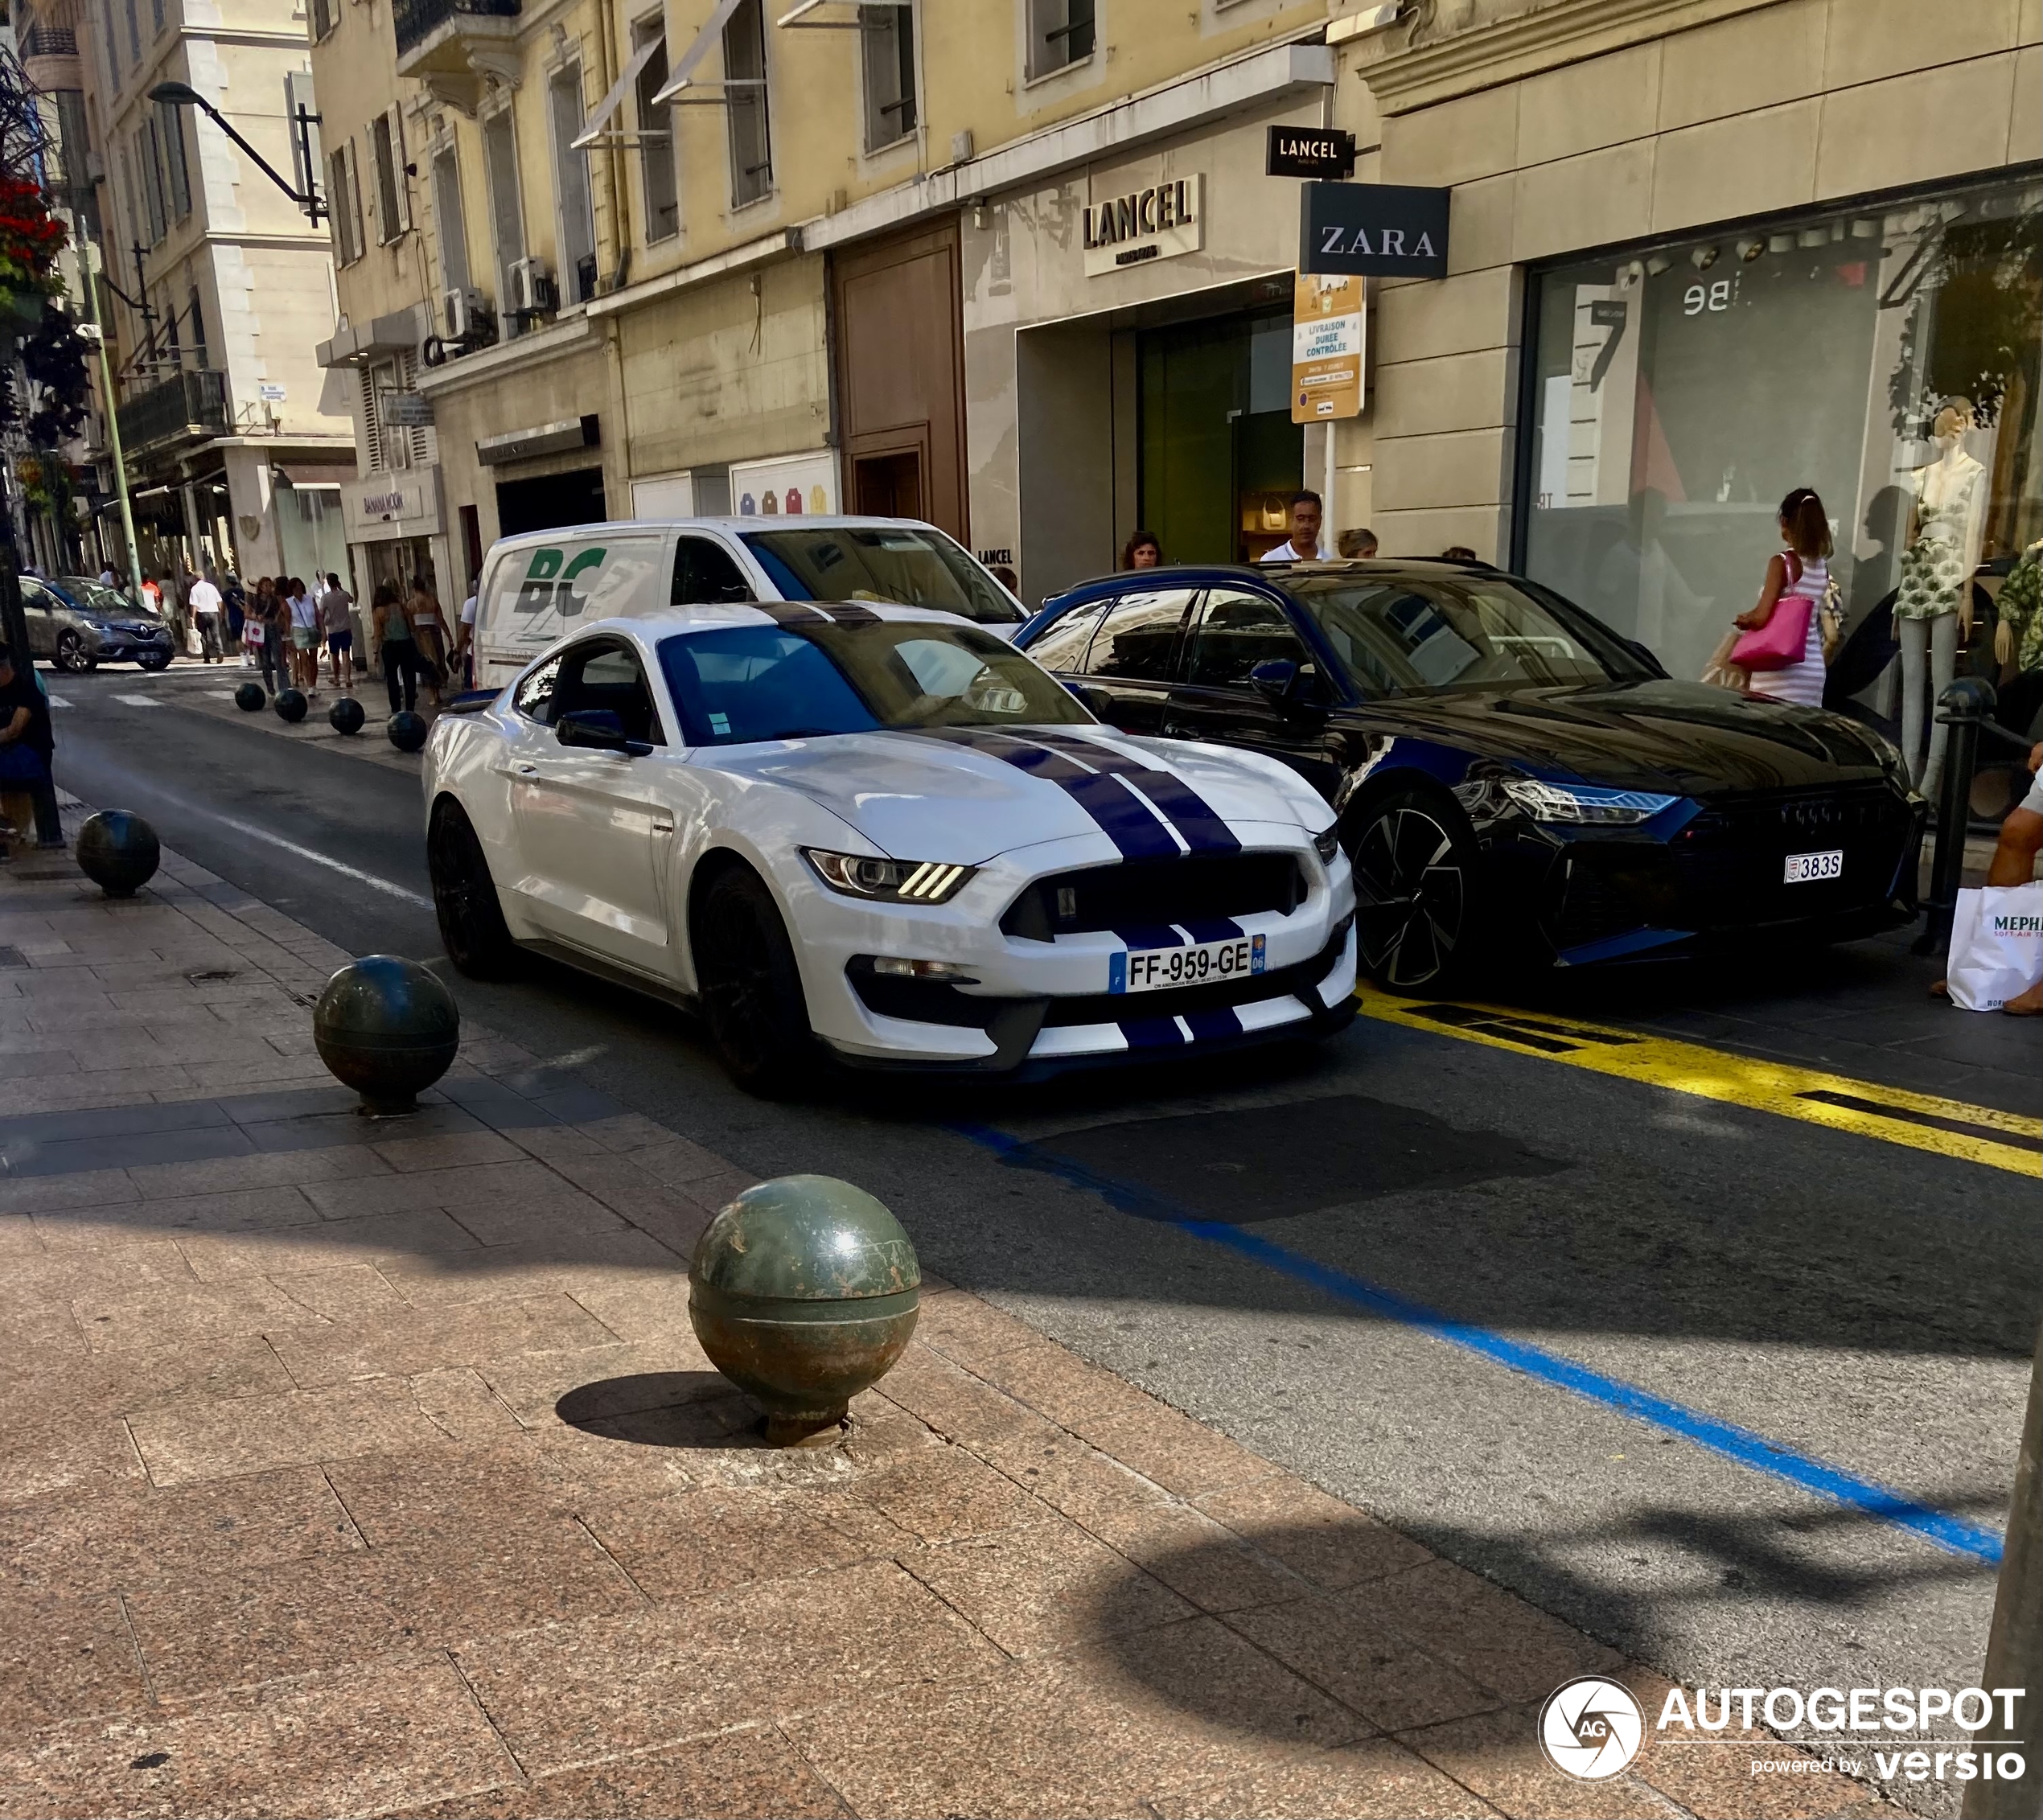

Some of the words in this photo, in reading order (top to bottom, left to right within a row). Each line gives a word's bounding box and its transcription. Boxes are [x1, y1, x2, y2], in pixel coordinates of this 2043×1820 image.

[1280, 138, 1338, 158] LANCEL
[1083, 180, 1193, 250] LANCEL
[1320, 226, 1438, 257] ZARA
[1309, 320, 1346, 335] LIVRAISON
[1306, 342, 1347, 357] CONTRÔLÉE
[978, 549, 1013, 565] LANCEL
[513, 548, 608, 617] BC
[1801, 855, 1840, 879] 383S
[1130, 943, 1249, 986] FF-959-GE
[1252, 956, 1264, 969] 06
[1115, 976, 1120, 985] F
